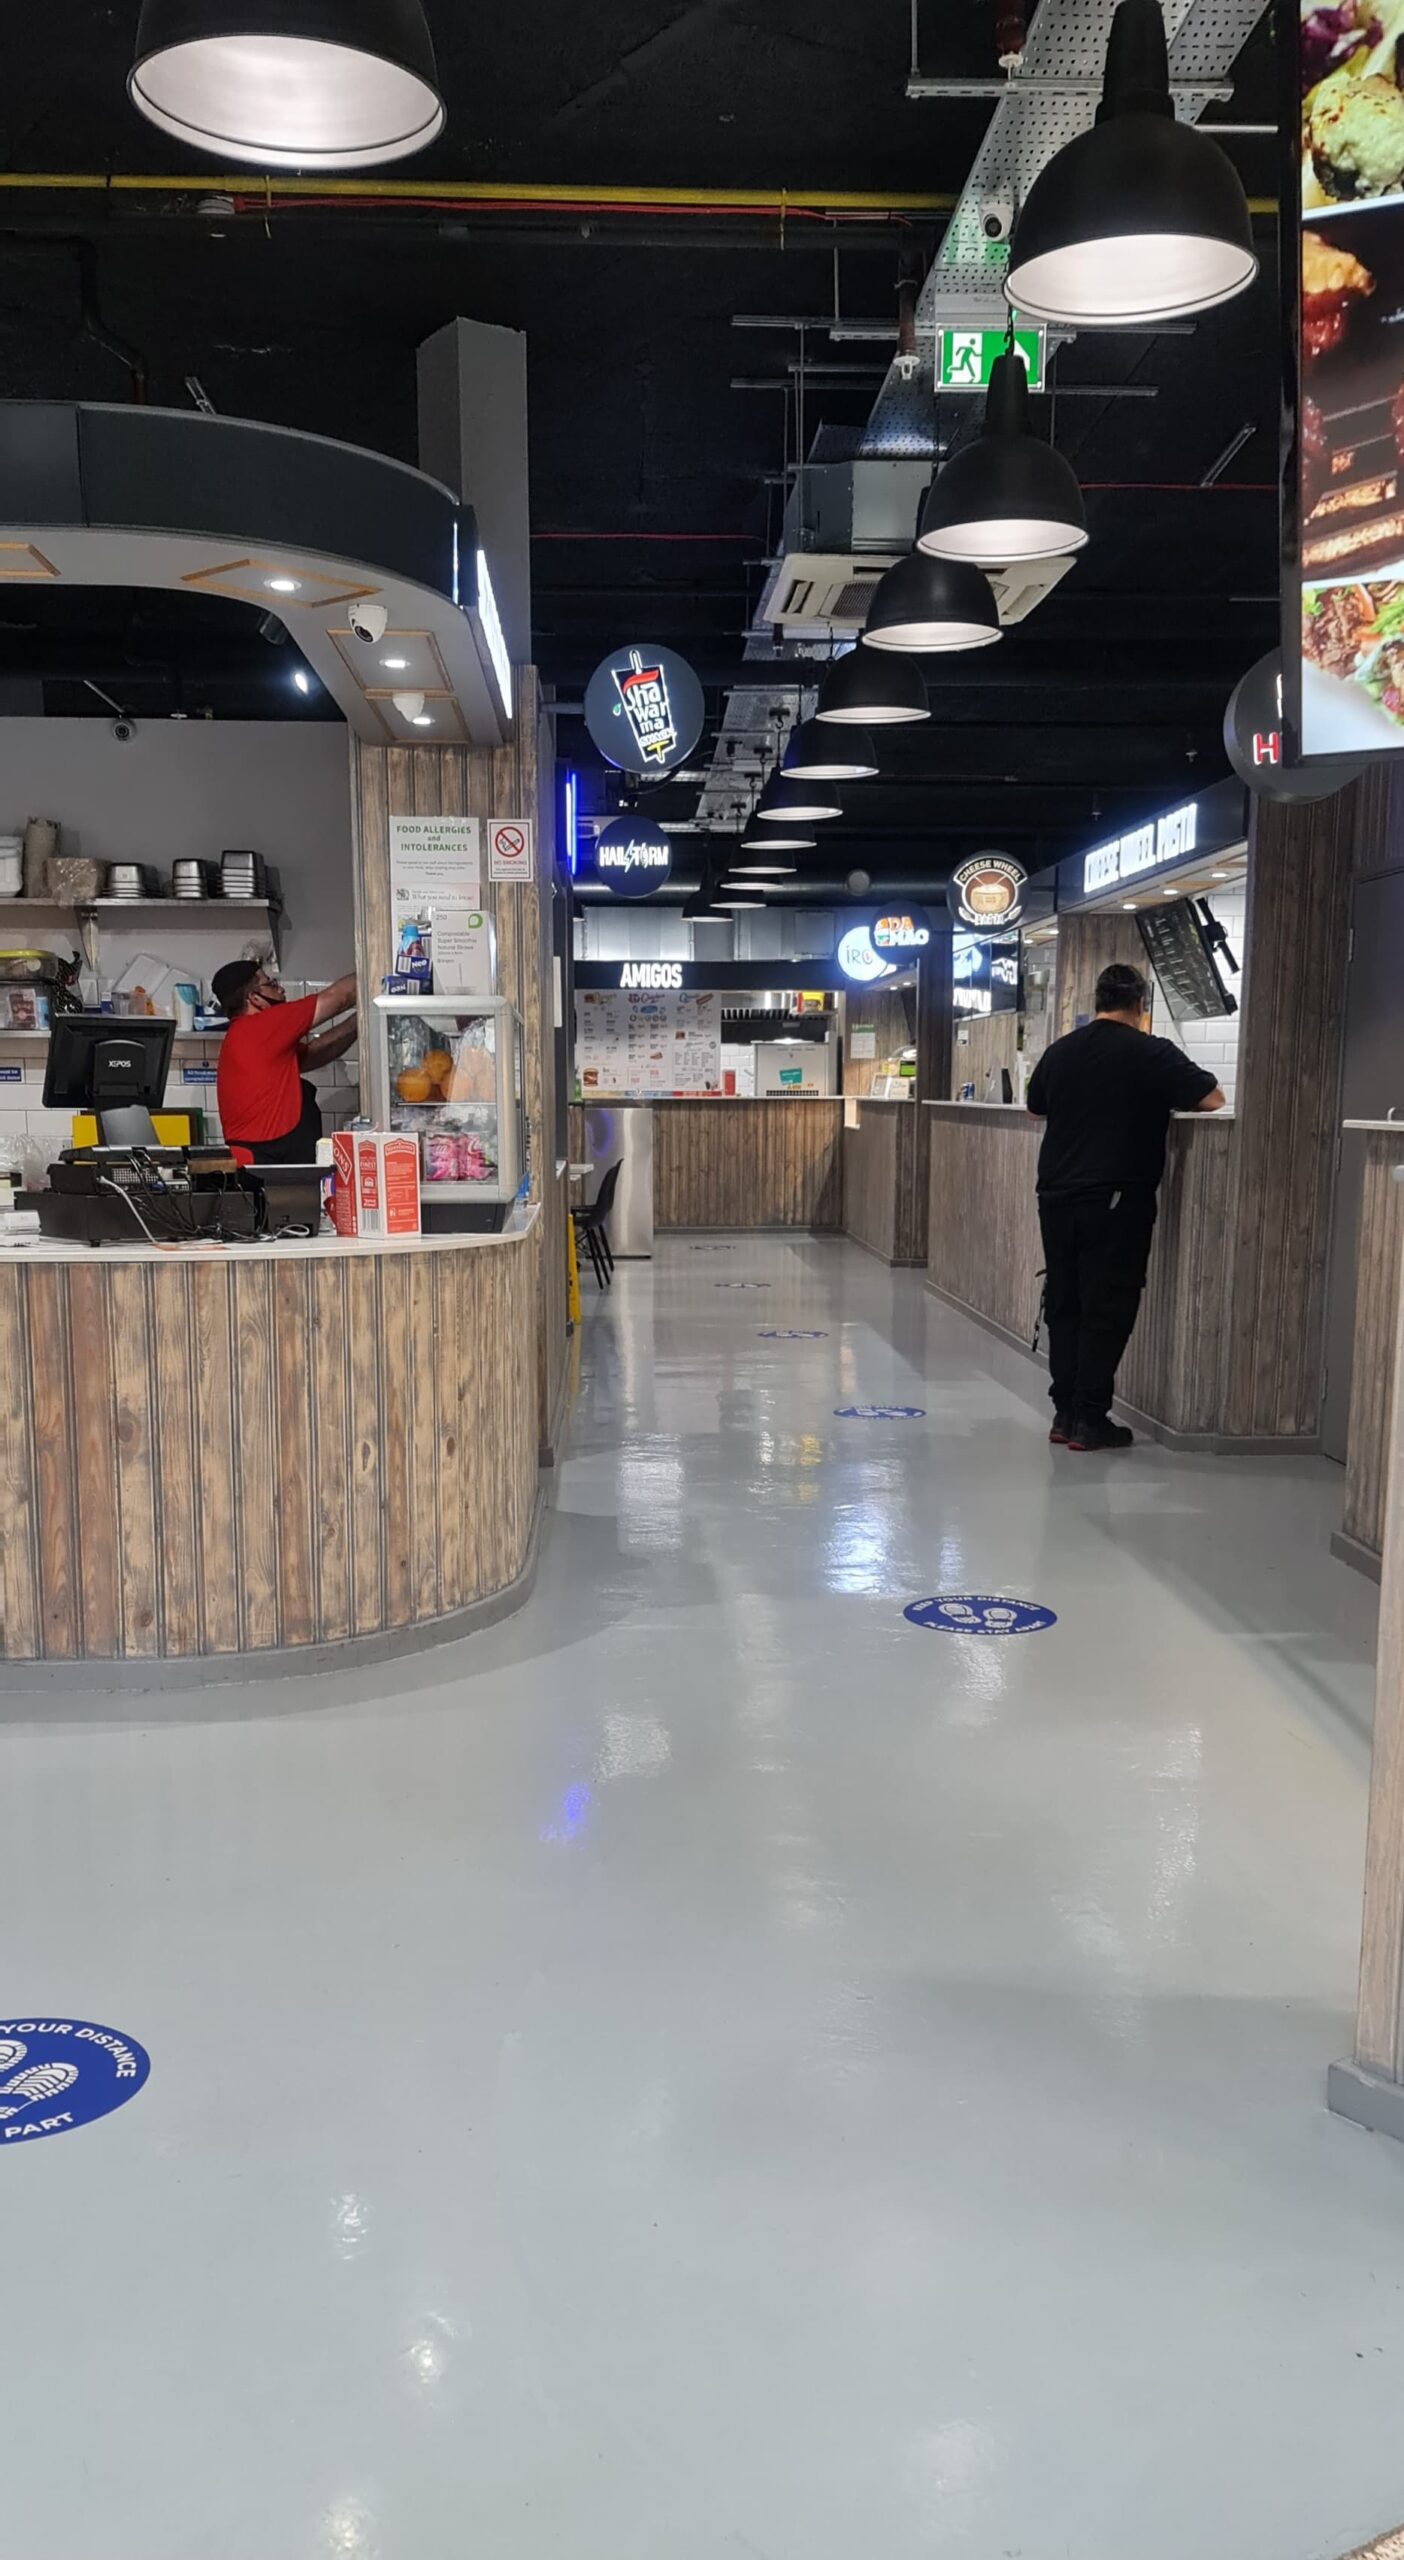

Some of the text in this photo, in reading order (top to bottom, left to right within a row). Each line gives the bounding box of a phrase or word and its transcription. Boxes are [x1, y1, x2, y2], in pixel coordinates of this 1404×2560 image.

[396, 825, 472, 834] FOOD ALLERGIES
[401, 842, 468, 852] INTOLERANCES
[960, 860, 1022, 881] CHEESE WHEEL
[620, 963, 682, 989] AMIGOS
[977, 1596, 1041, 1611] DISTANCE
[923, 1621, 973, 1633] PLEASE
[0, 2023, 137, 2078] YOUR DISTANCE
